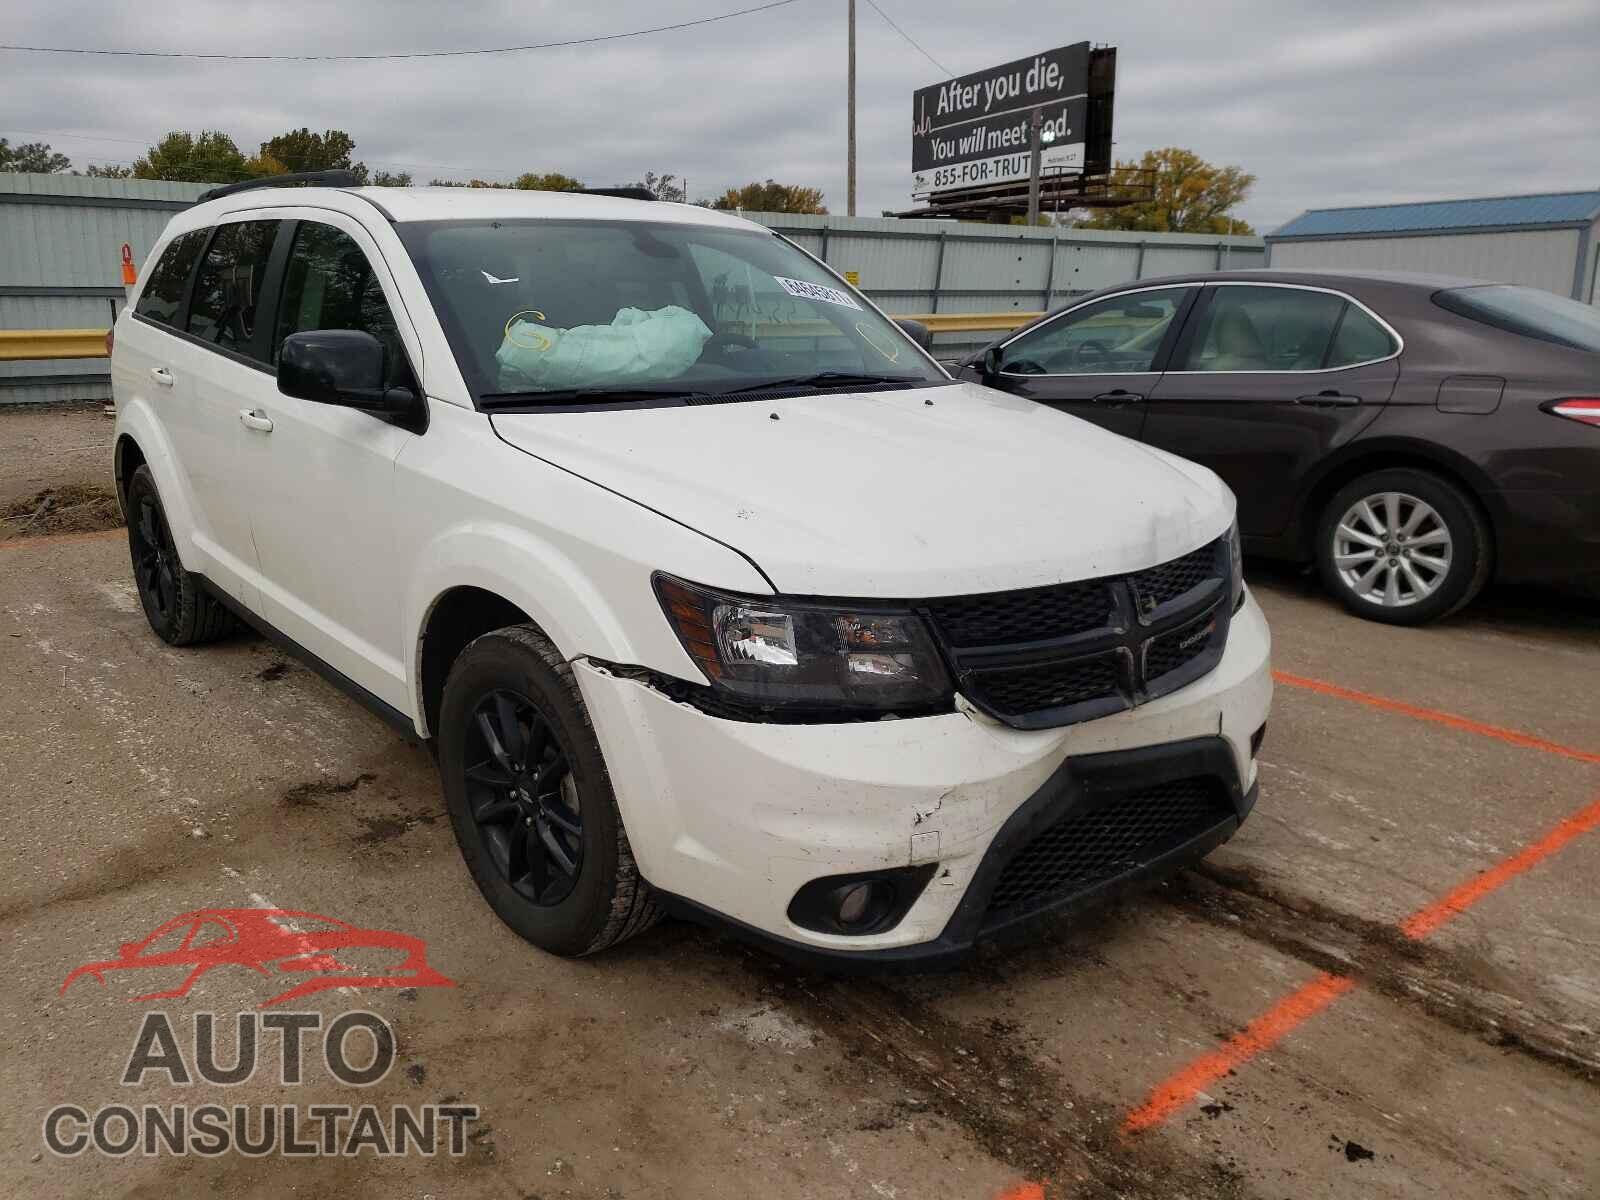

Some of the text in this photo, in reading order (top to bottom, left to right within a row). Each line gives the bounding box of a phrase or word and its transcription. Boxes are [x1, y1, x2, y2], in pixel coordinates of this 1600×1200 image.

[937, 57, 1065, 115] After you die,
[931, 109, 1072, 160] You will meet od.
[934, 155, 1032, 187] 855-FOR-TRUT
